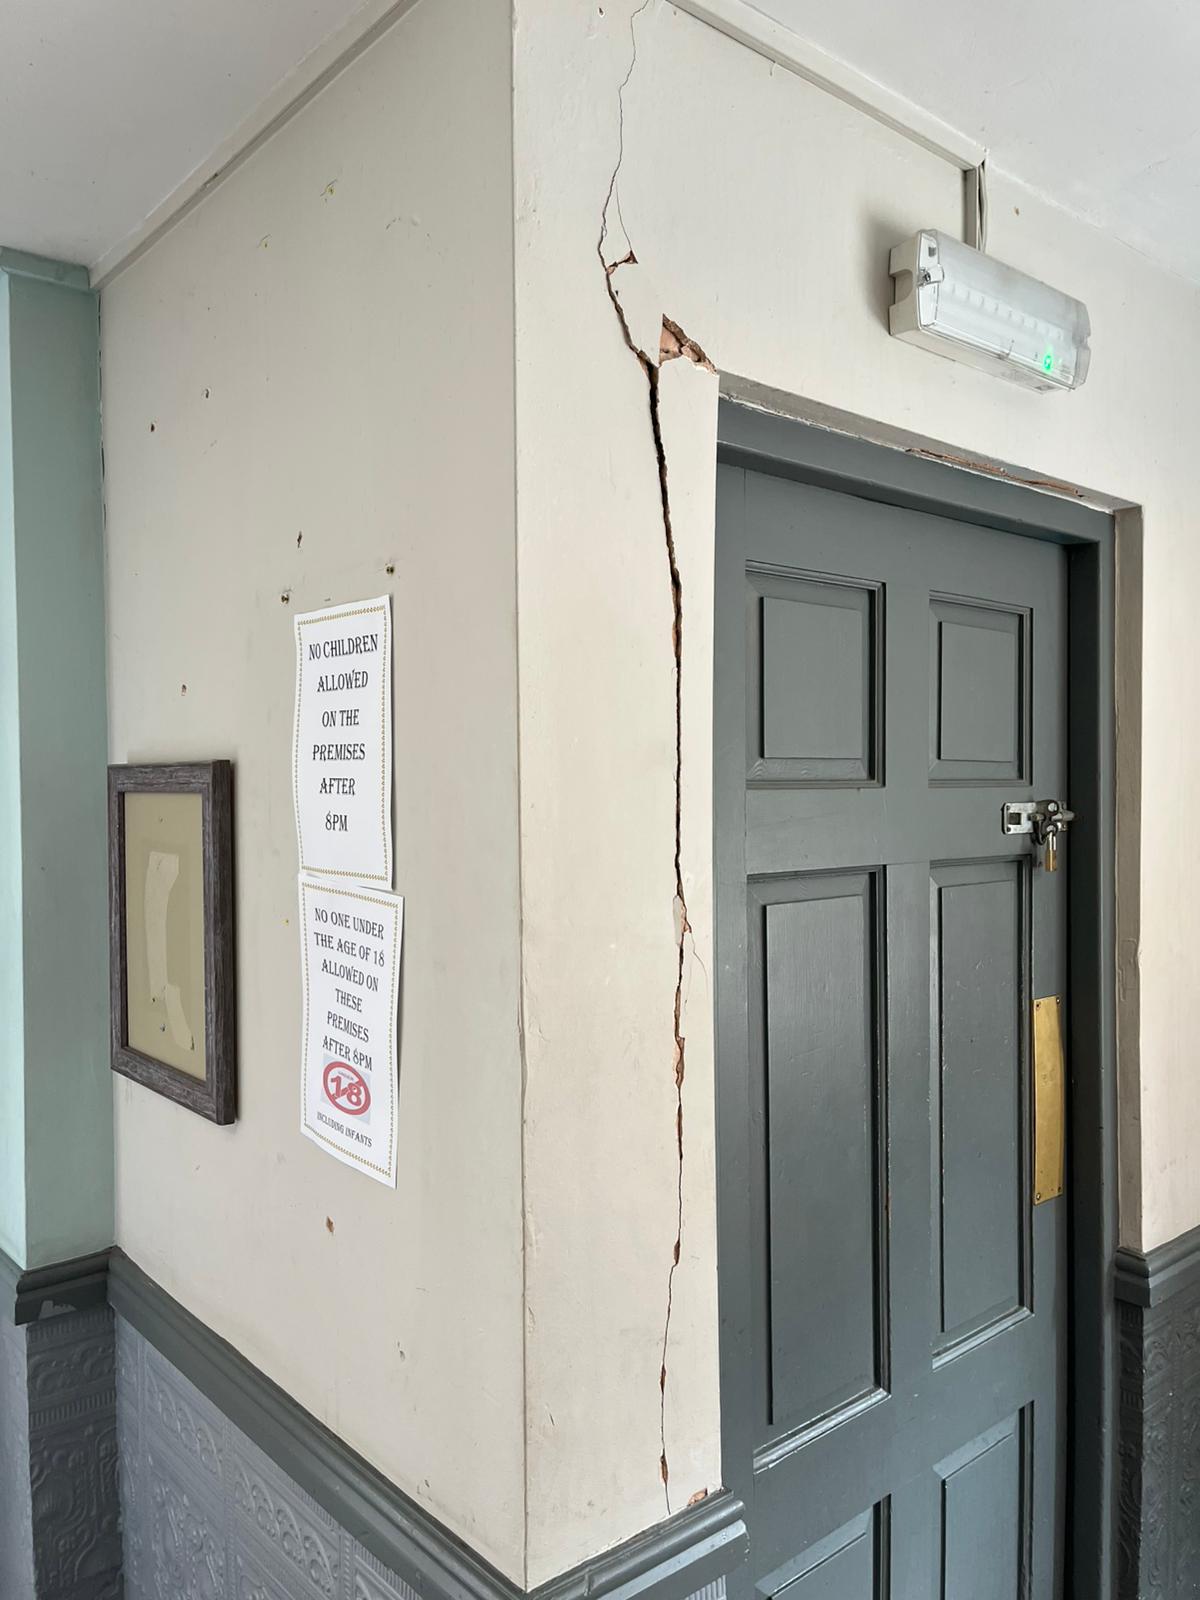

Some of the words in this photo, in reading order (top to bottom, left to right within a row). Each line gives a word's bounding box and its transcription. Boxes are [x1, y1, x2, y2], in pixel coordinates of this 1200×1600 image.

[309, 643, 321, 660] NO
[323, 634, 378, 658] CHILDREN
[317, 669, 368, 692] ALLOWED
[322, 711, 337, 727] ON
[339, 709, 359, 727] THE
[313, 743, 365, 762] PREMISES
[320, 777, 356, 796] AFTER
[325, 811, 348, 832] 8PM
[315, 908, 328, 923] NO
[331, 911, 350, 929] ONE
[353, 917, 384, 940] UNDER
[314, 932, 334, 949] THE
[337, 938, 357, 957] AGE
[359, 945, 371, 961] OF
[373, 950, 385, 967] 18
[321, 958, 365, 986] ALLOWED
[366, 975, 379, 992] ON
[335, 988, 362, 1013] THESE
[327, 1011, 369, 1043] PREMISES
[322, 1035, 351, 1061] AFTER
[352, 1048, 372, 1071] 8PM
[330, 1075, 362, 1106] 18
[317, 1111, 345, 1135] INCLUDING
[345, 1128, 372, 1148] INFANTS
